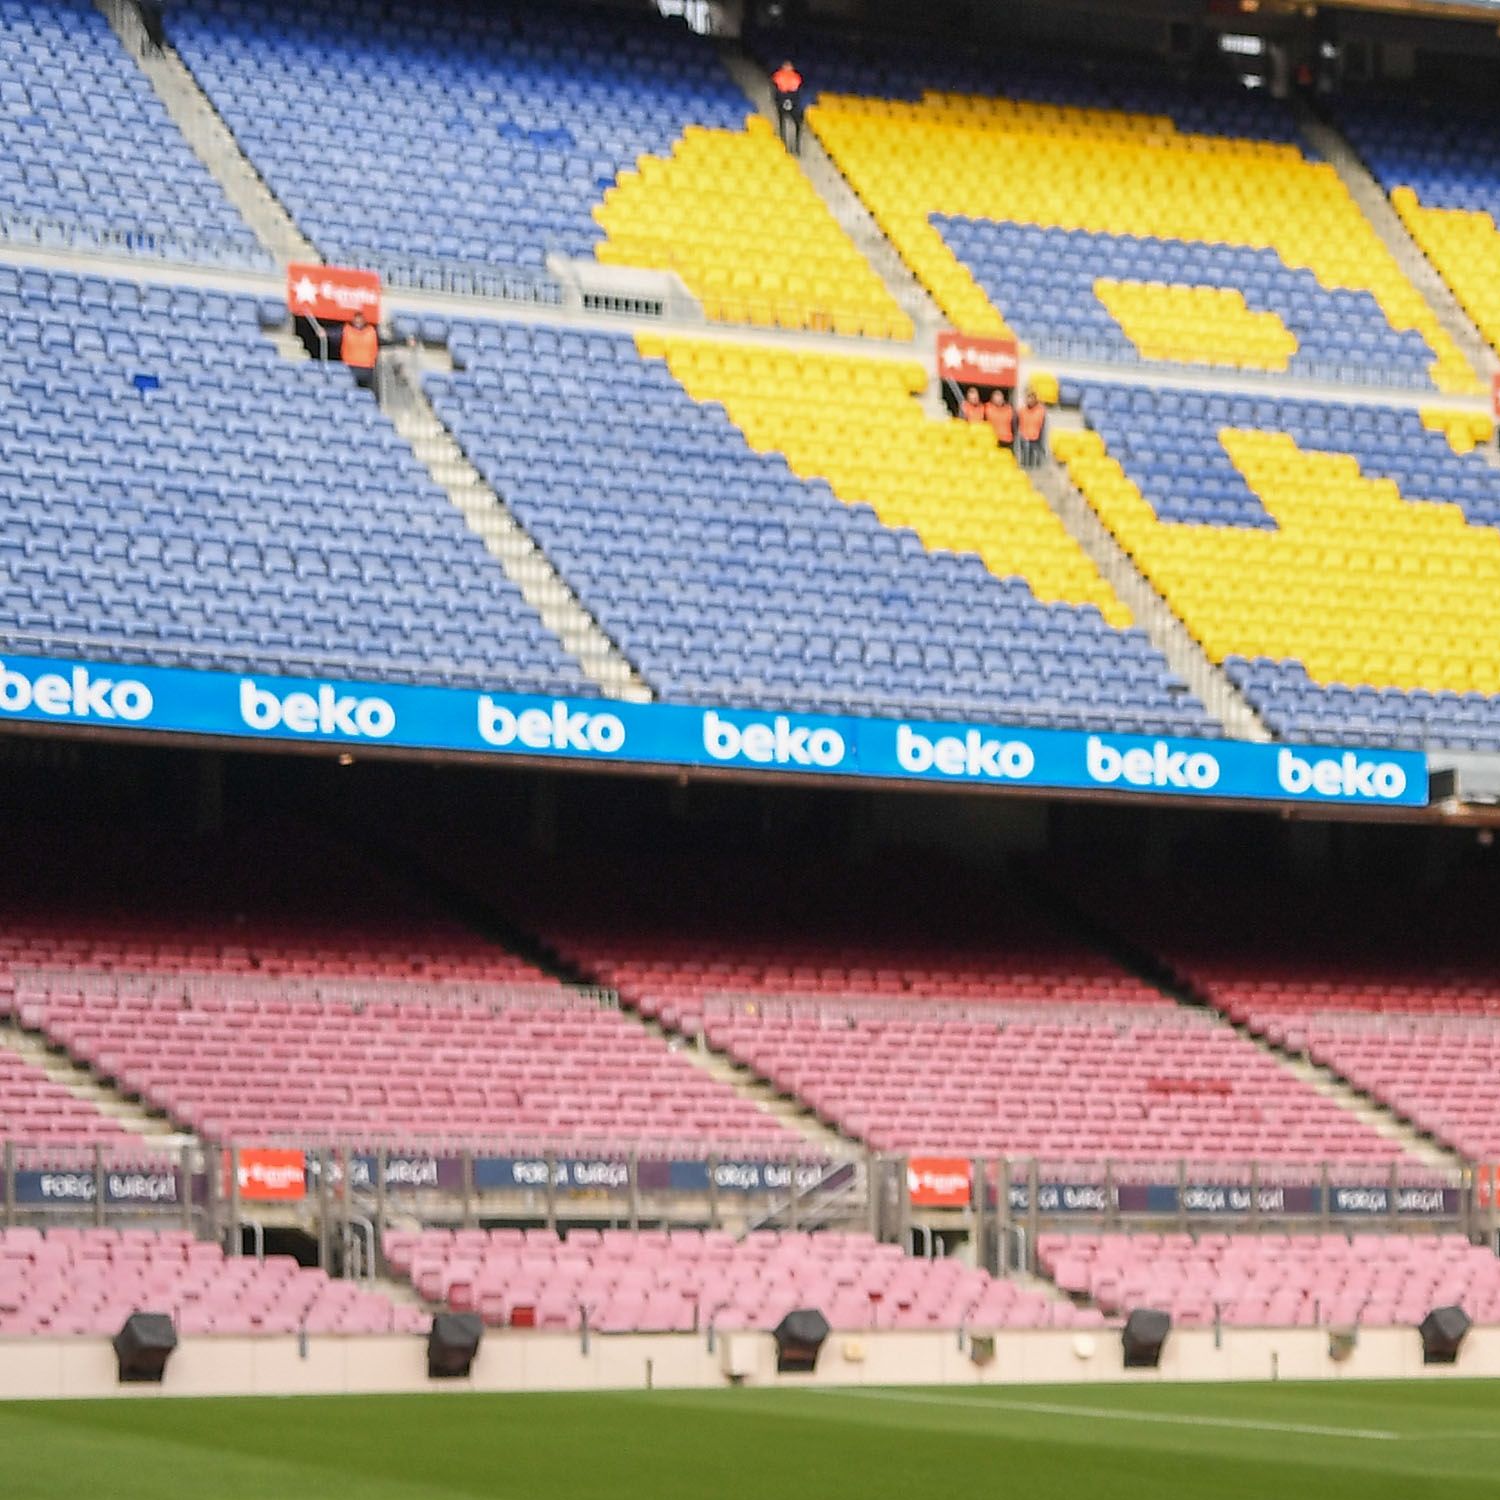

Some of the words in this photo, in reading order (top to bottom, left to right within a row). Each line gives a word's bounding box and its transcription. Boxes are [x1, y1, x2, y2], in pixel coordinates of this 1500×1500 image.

[0, 660, 153, 720] beko
[240, 678, 396, 738] beko
[478, 695, 625, 752] beko
[704, 711, 845, 766] beko
[897, 725, 1035, 778] beko
[1087, 737, 1220, 789] beko
[1278, 748, 1406, 798] beko
